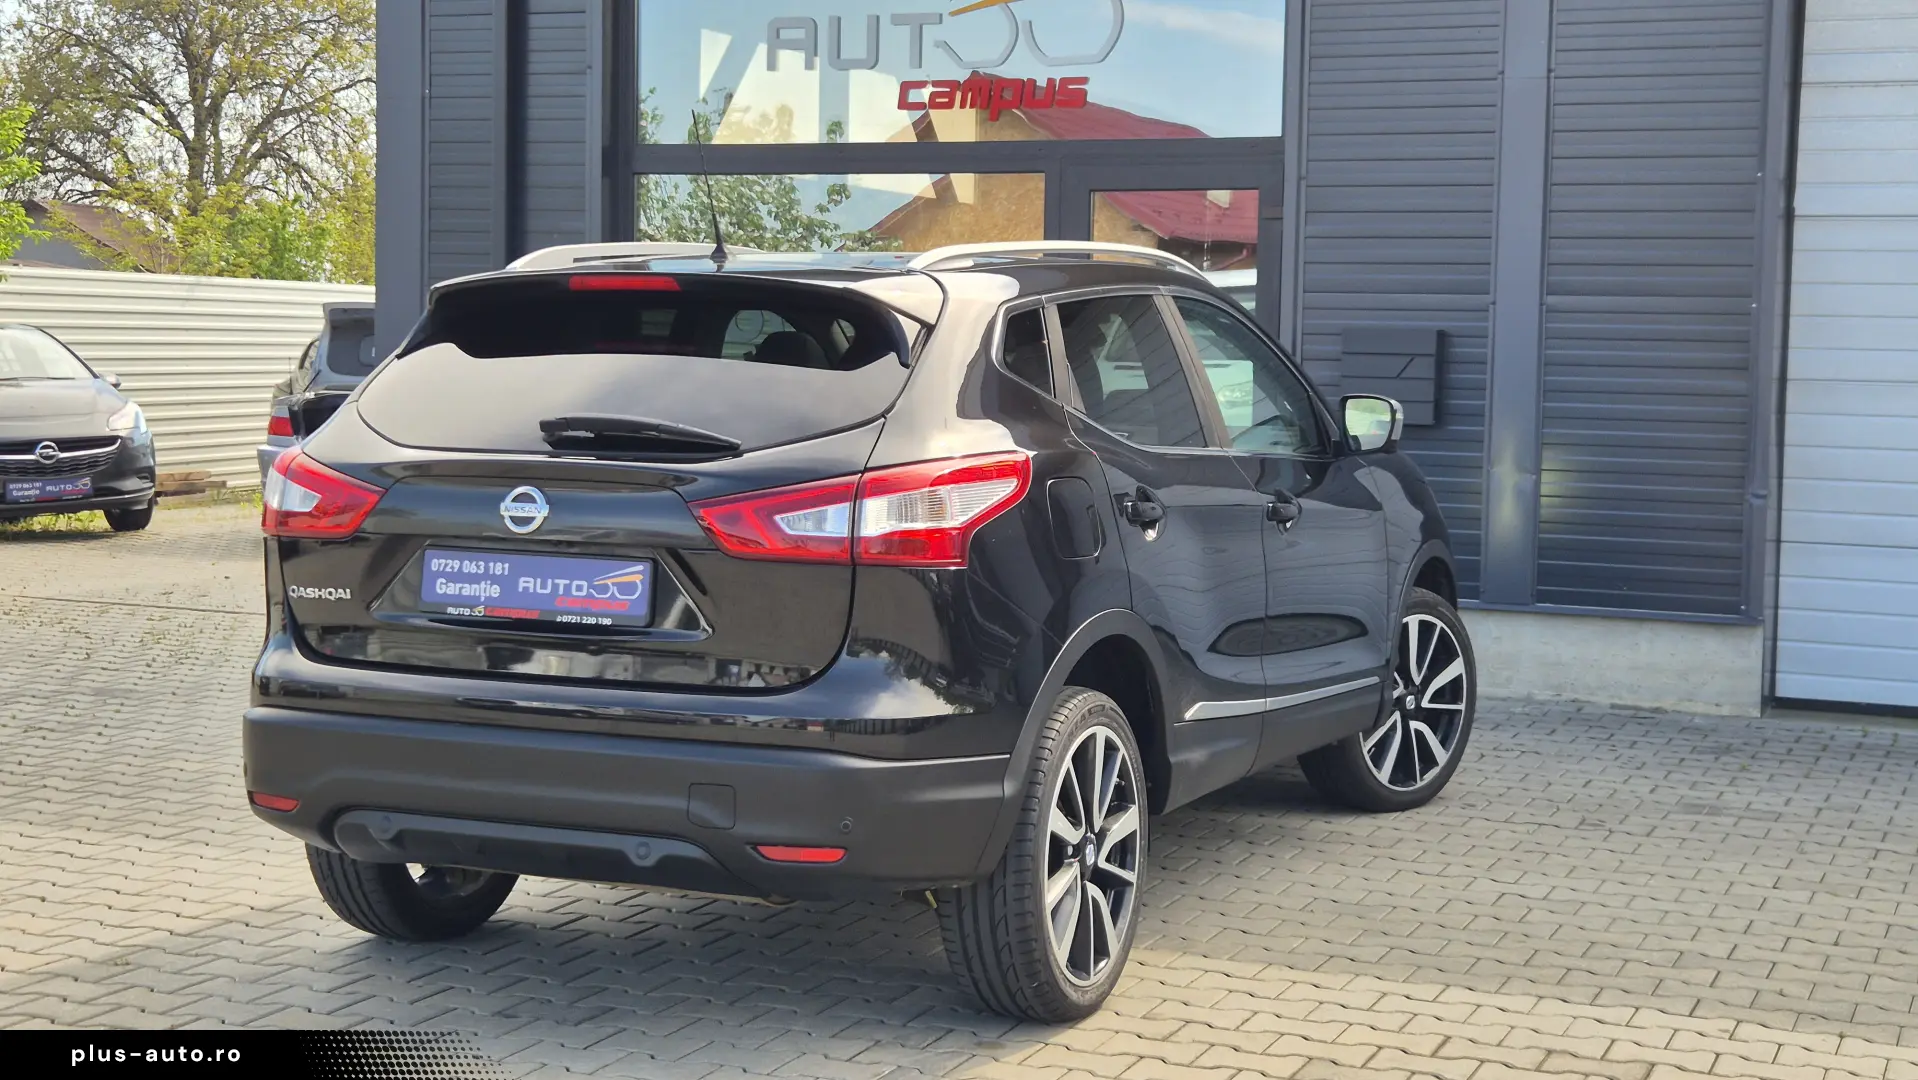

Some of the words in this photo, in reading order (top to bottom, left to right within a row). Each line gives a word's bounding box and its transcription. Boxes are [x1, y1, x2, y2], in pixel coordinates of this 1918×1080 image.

[898, 76, 1089, 122] campus
[503, 505, 541, 514] NISSAN
[431, 558, 460, 572] 0729
[462, 560, 485, 574] 063
[488, 562, 510, 576] 181
[289, 585, 352, 601] QASHQAI
[435, 577, 501, 602] Garanție
[518, 577, 588, 596] AUTO
[446, 606, 471, 616] AUTO
[562, 615, 581, 624] 0721
[581, 616, 597, 625] 220
